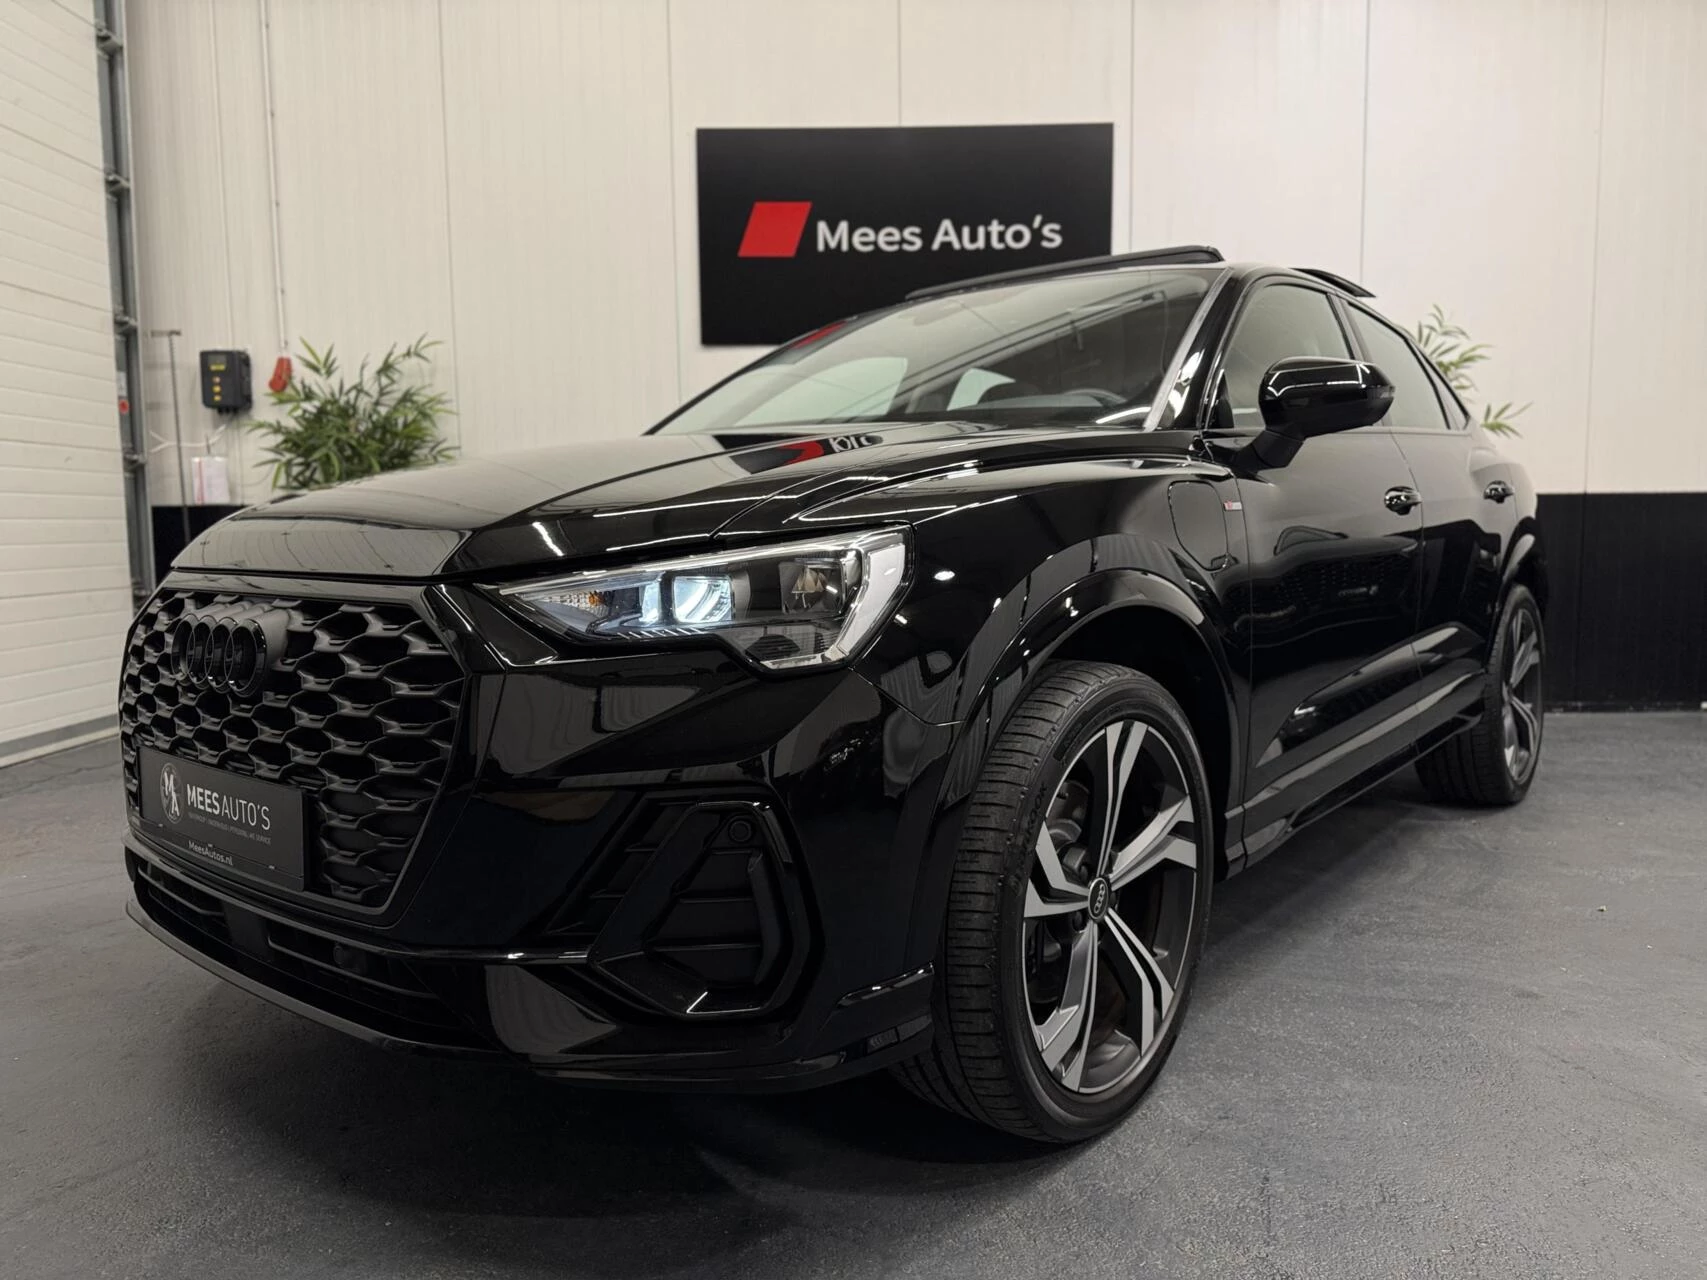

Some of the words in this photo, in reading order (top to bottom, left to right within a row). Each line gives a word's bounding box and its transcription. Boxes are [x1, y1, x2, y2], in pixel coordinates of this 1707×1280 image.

[816, 219, 923, 253] Mees
[931, 214, 1063, 252] Auto's
[188, 839, 234, 866] MeesAutos.nl
